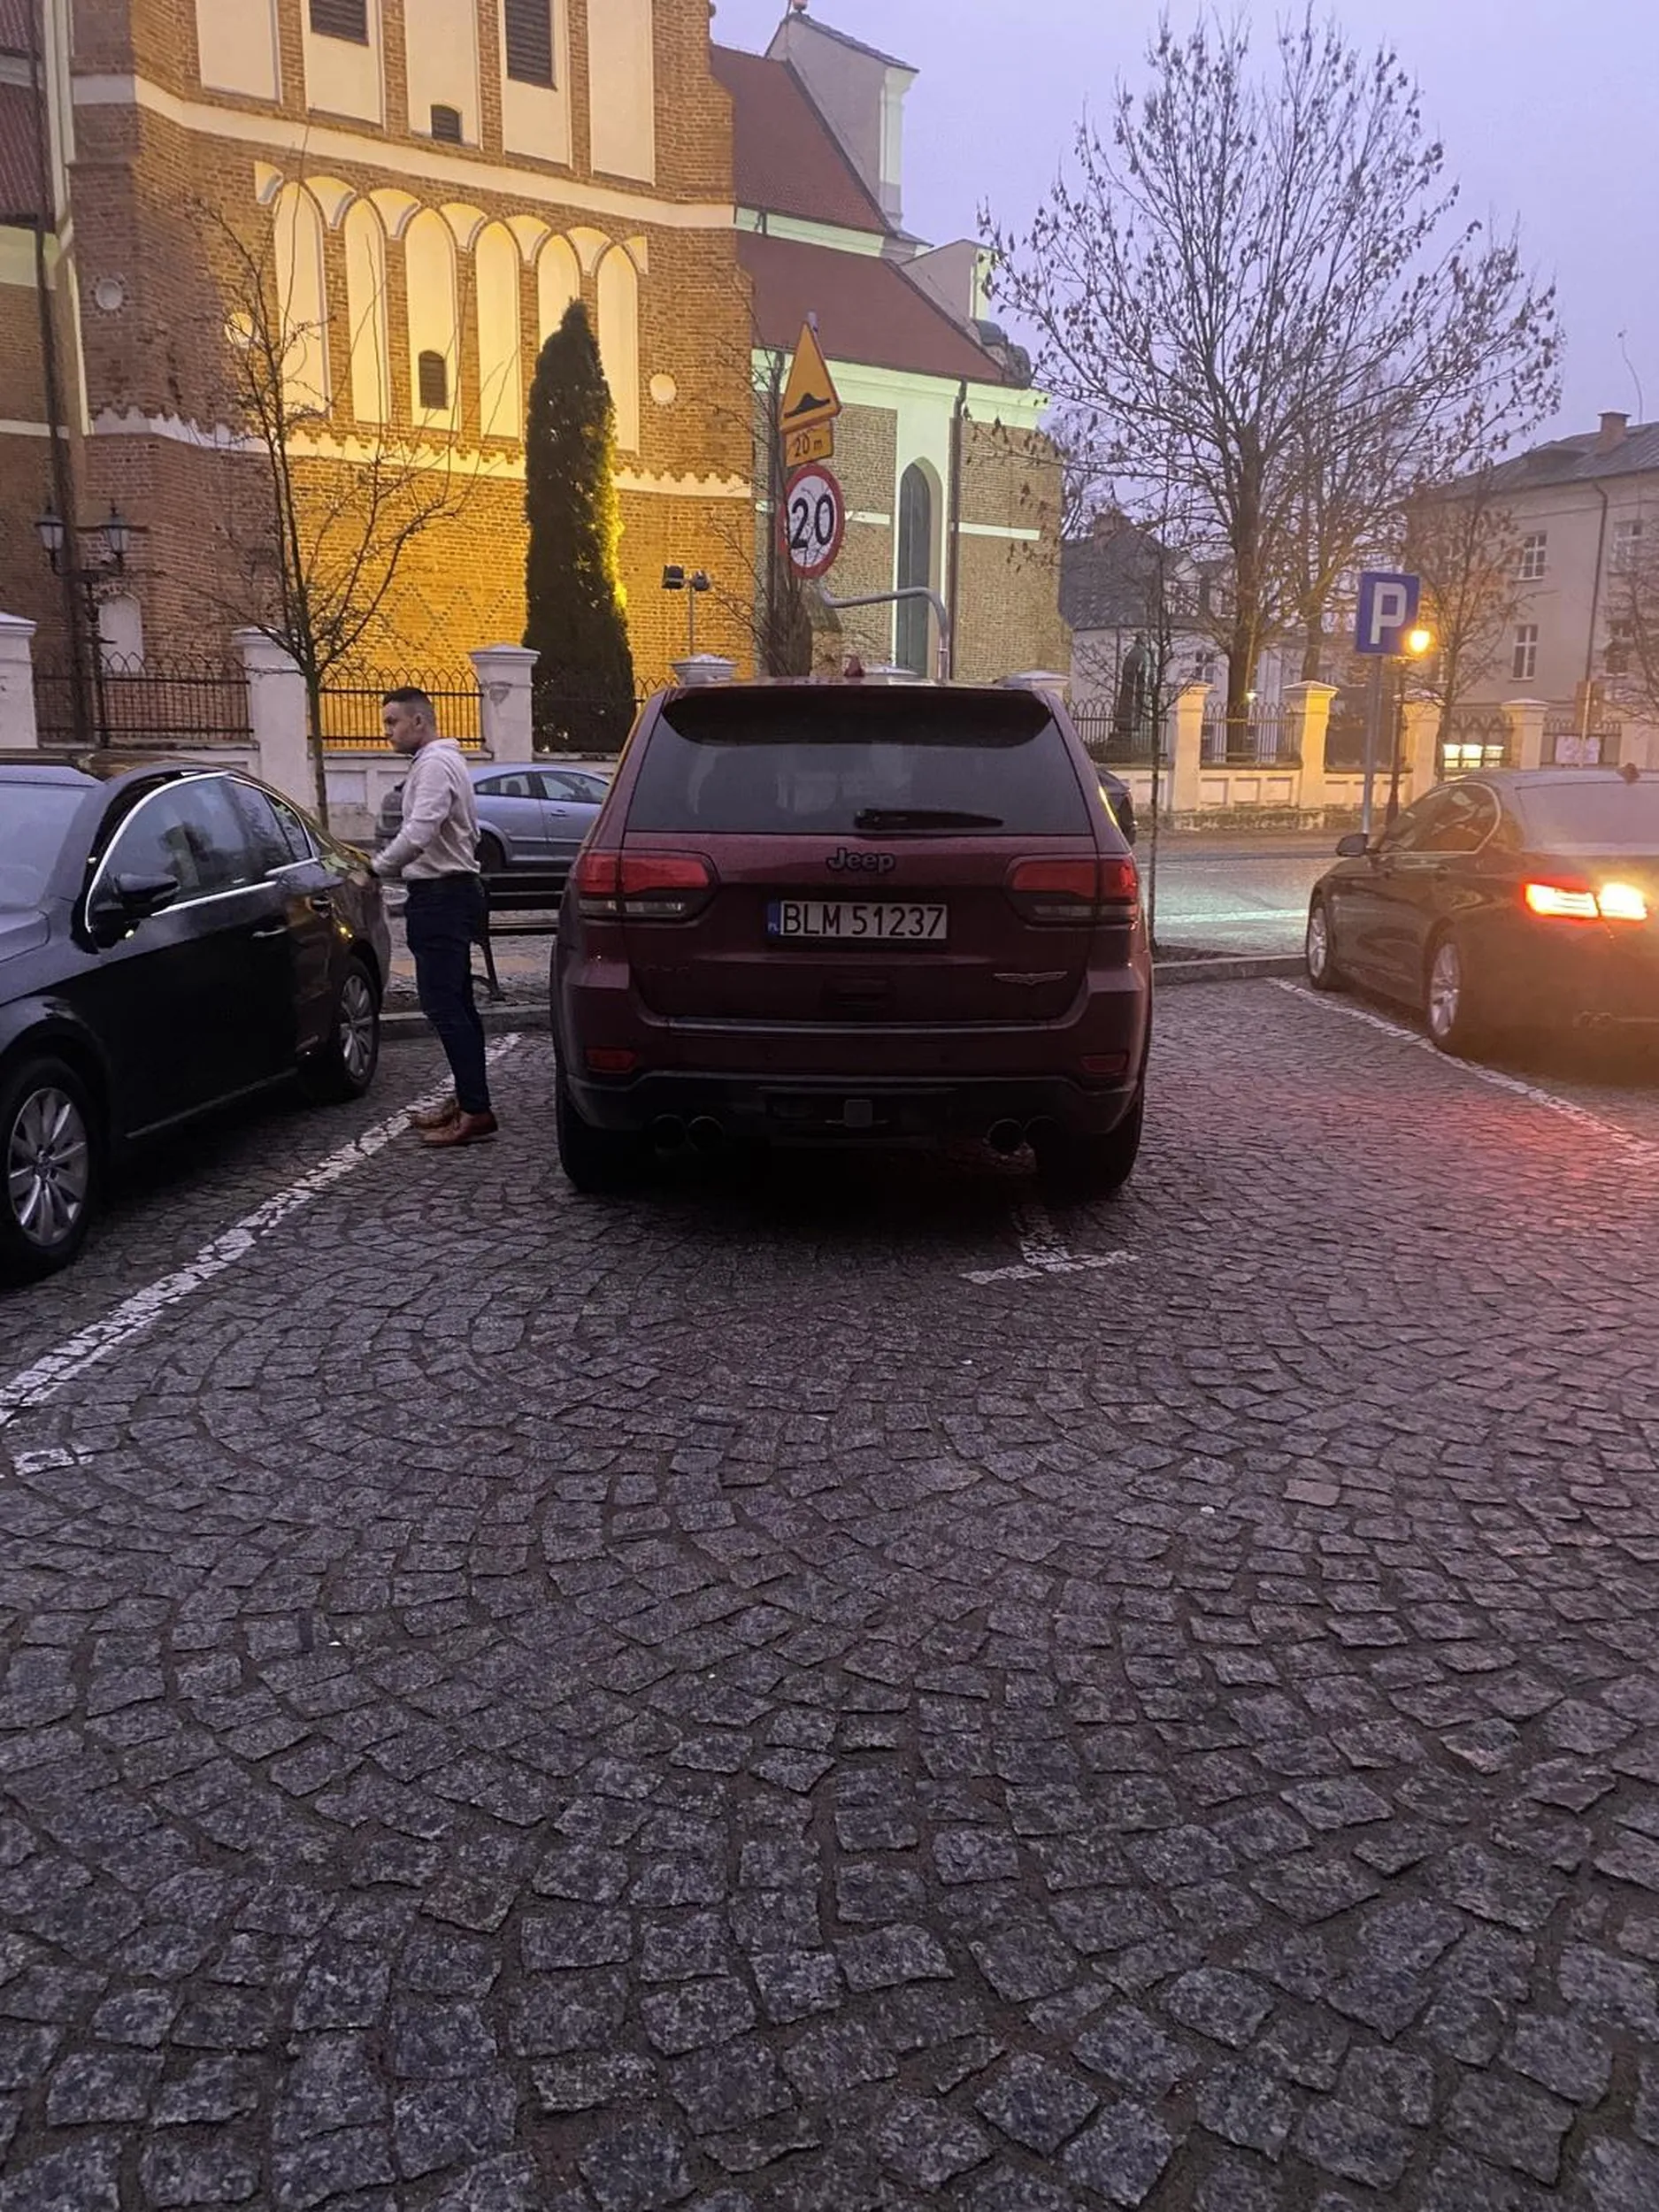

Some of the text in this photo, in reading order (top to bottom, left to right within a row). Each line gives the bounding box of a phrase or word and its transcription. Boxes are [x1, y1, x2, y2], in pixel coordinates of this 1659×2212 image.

[794, 432, 823, 457] 20 m
[791, 494, 834, 549] 20
[1369, 581, 1408, 645] P
[826, 847, 897, 873] Jeep
[784, 903, 944, 937] BLM 51237
